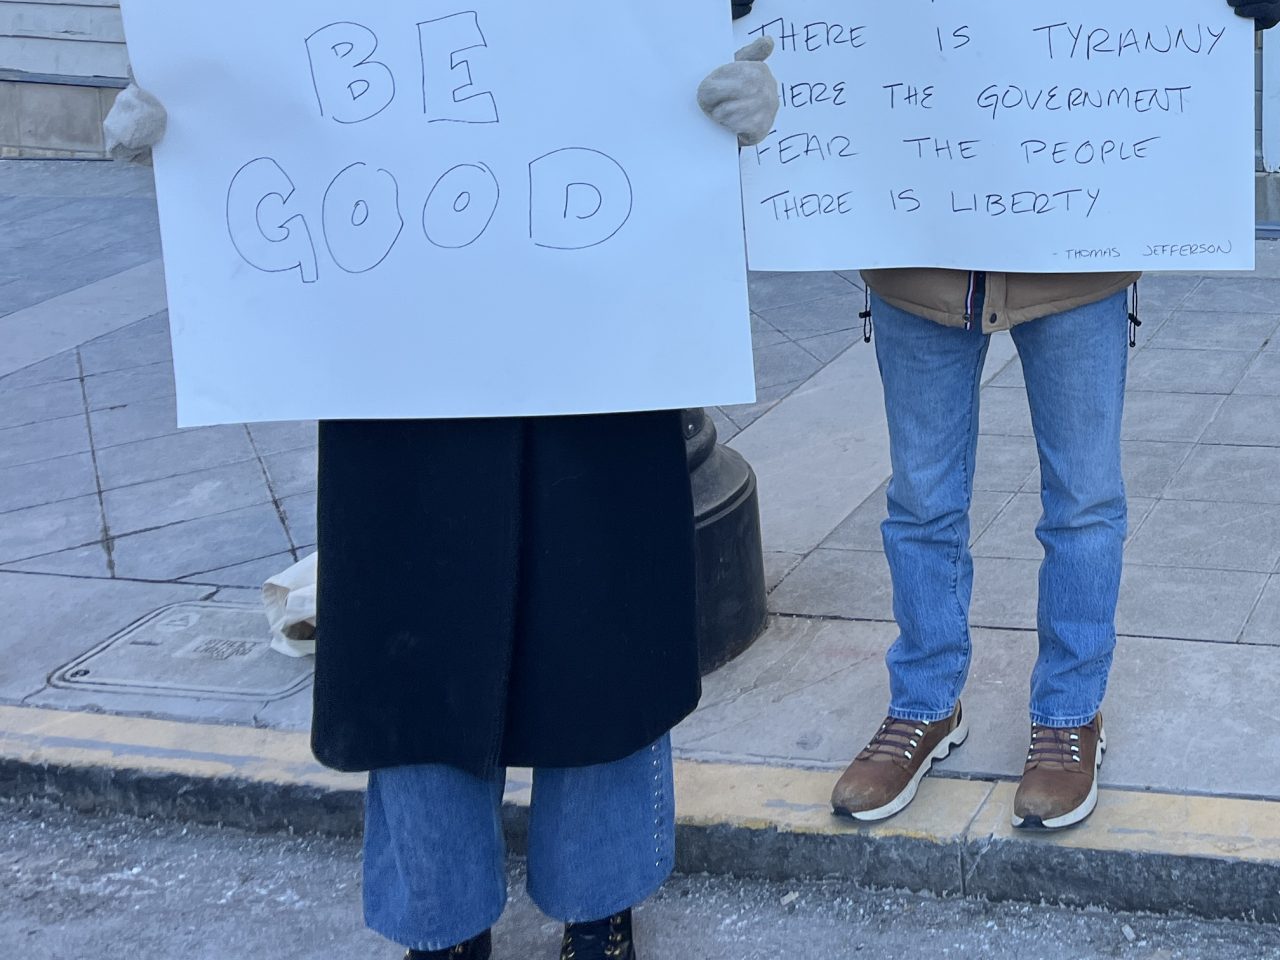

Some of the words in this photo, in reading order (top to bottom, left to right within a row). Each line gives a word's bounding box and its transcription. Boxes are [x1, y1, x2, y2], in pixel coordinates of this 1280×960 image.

[937, 25, 971, 51] IS
[1033, 22, 1226, 60] TYRANNY
[304, 10, 499, 124] BE
[883, 83, 935, 110] THE
[977, 84, 1191, 120] GOVERNMENT
[903, 138, 981, 160] THE
[1021, 136, 1162, 165] PEOPLE
[226, 147, 633, 283] GOOD
[760, 190, 854, 221] THERE
[890, 189, 921, 211] IS
[951, 188, 1101, 218] LIBERTY
[1065, 246, 1121, 259] THOMAS
[1142, 240, 1233, 258] JEFFERSON
